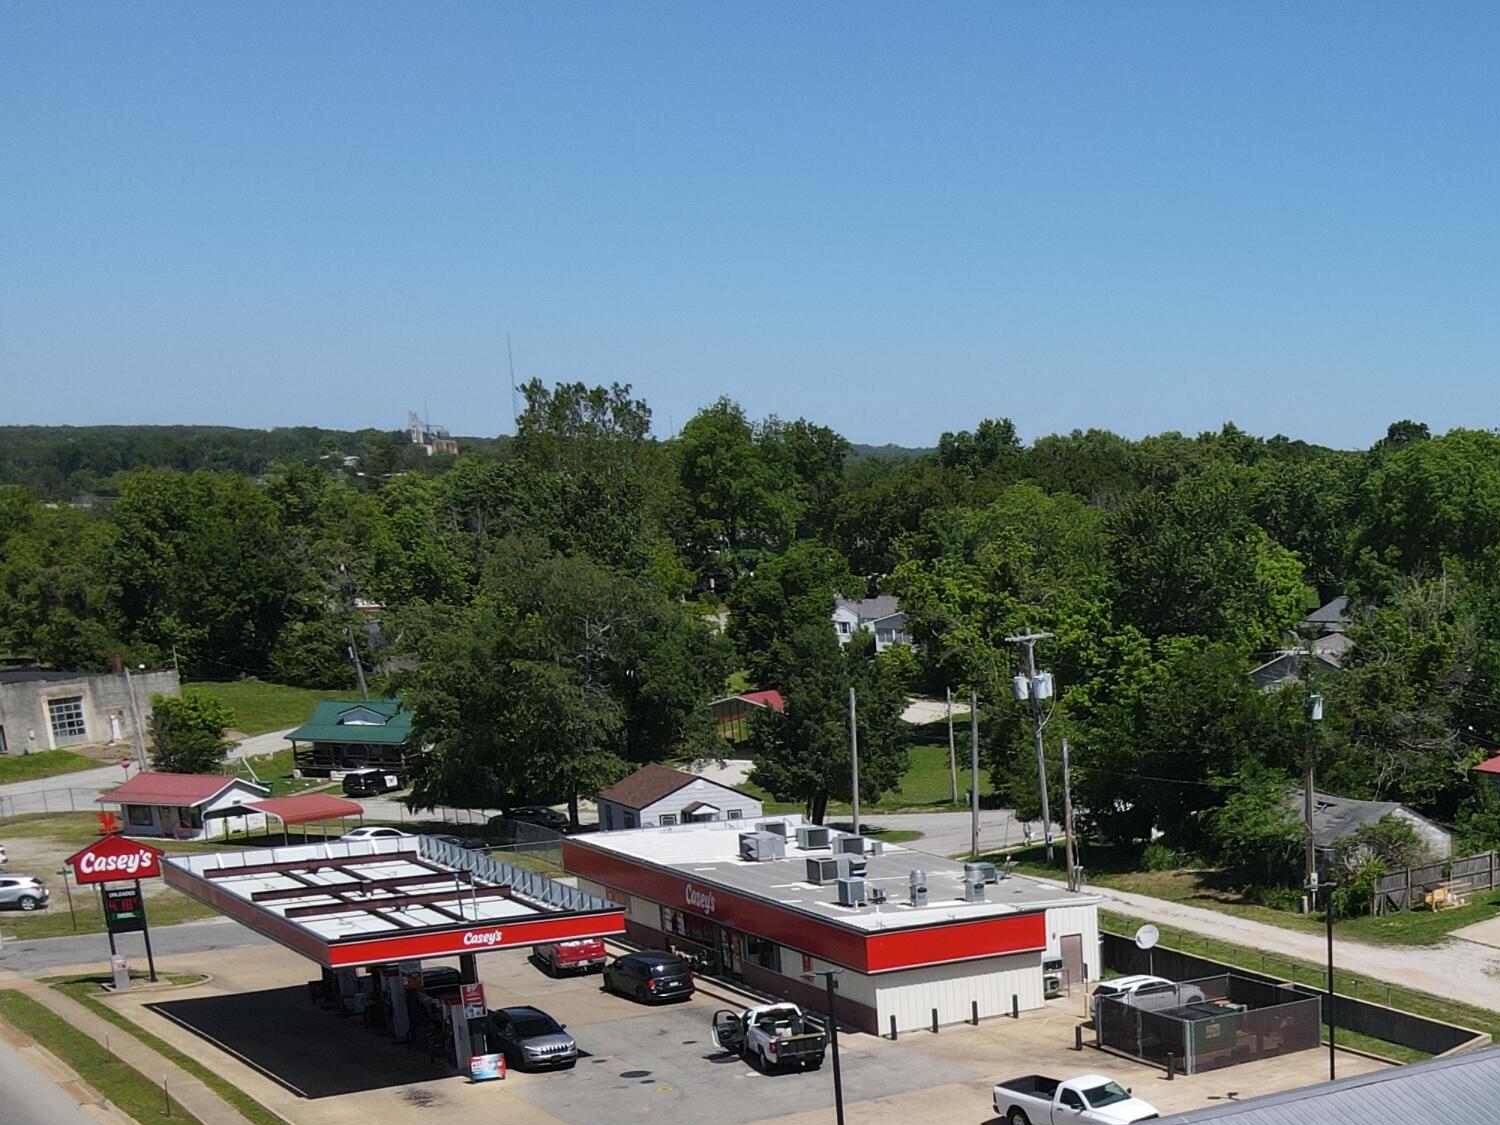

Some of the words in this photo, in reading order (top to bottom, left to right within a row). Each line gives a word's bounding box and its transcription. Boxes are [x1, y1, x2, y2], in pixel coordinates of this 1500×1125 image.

[80, 850, 152, 873] Casey's
[685, 883, 716, 915] Casey's
[463, 929, 502, 945] Casey's
